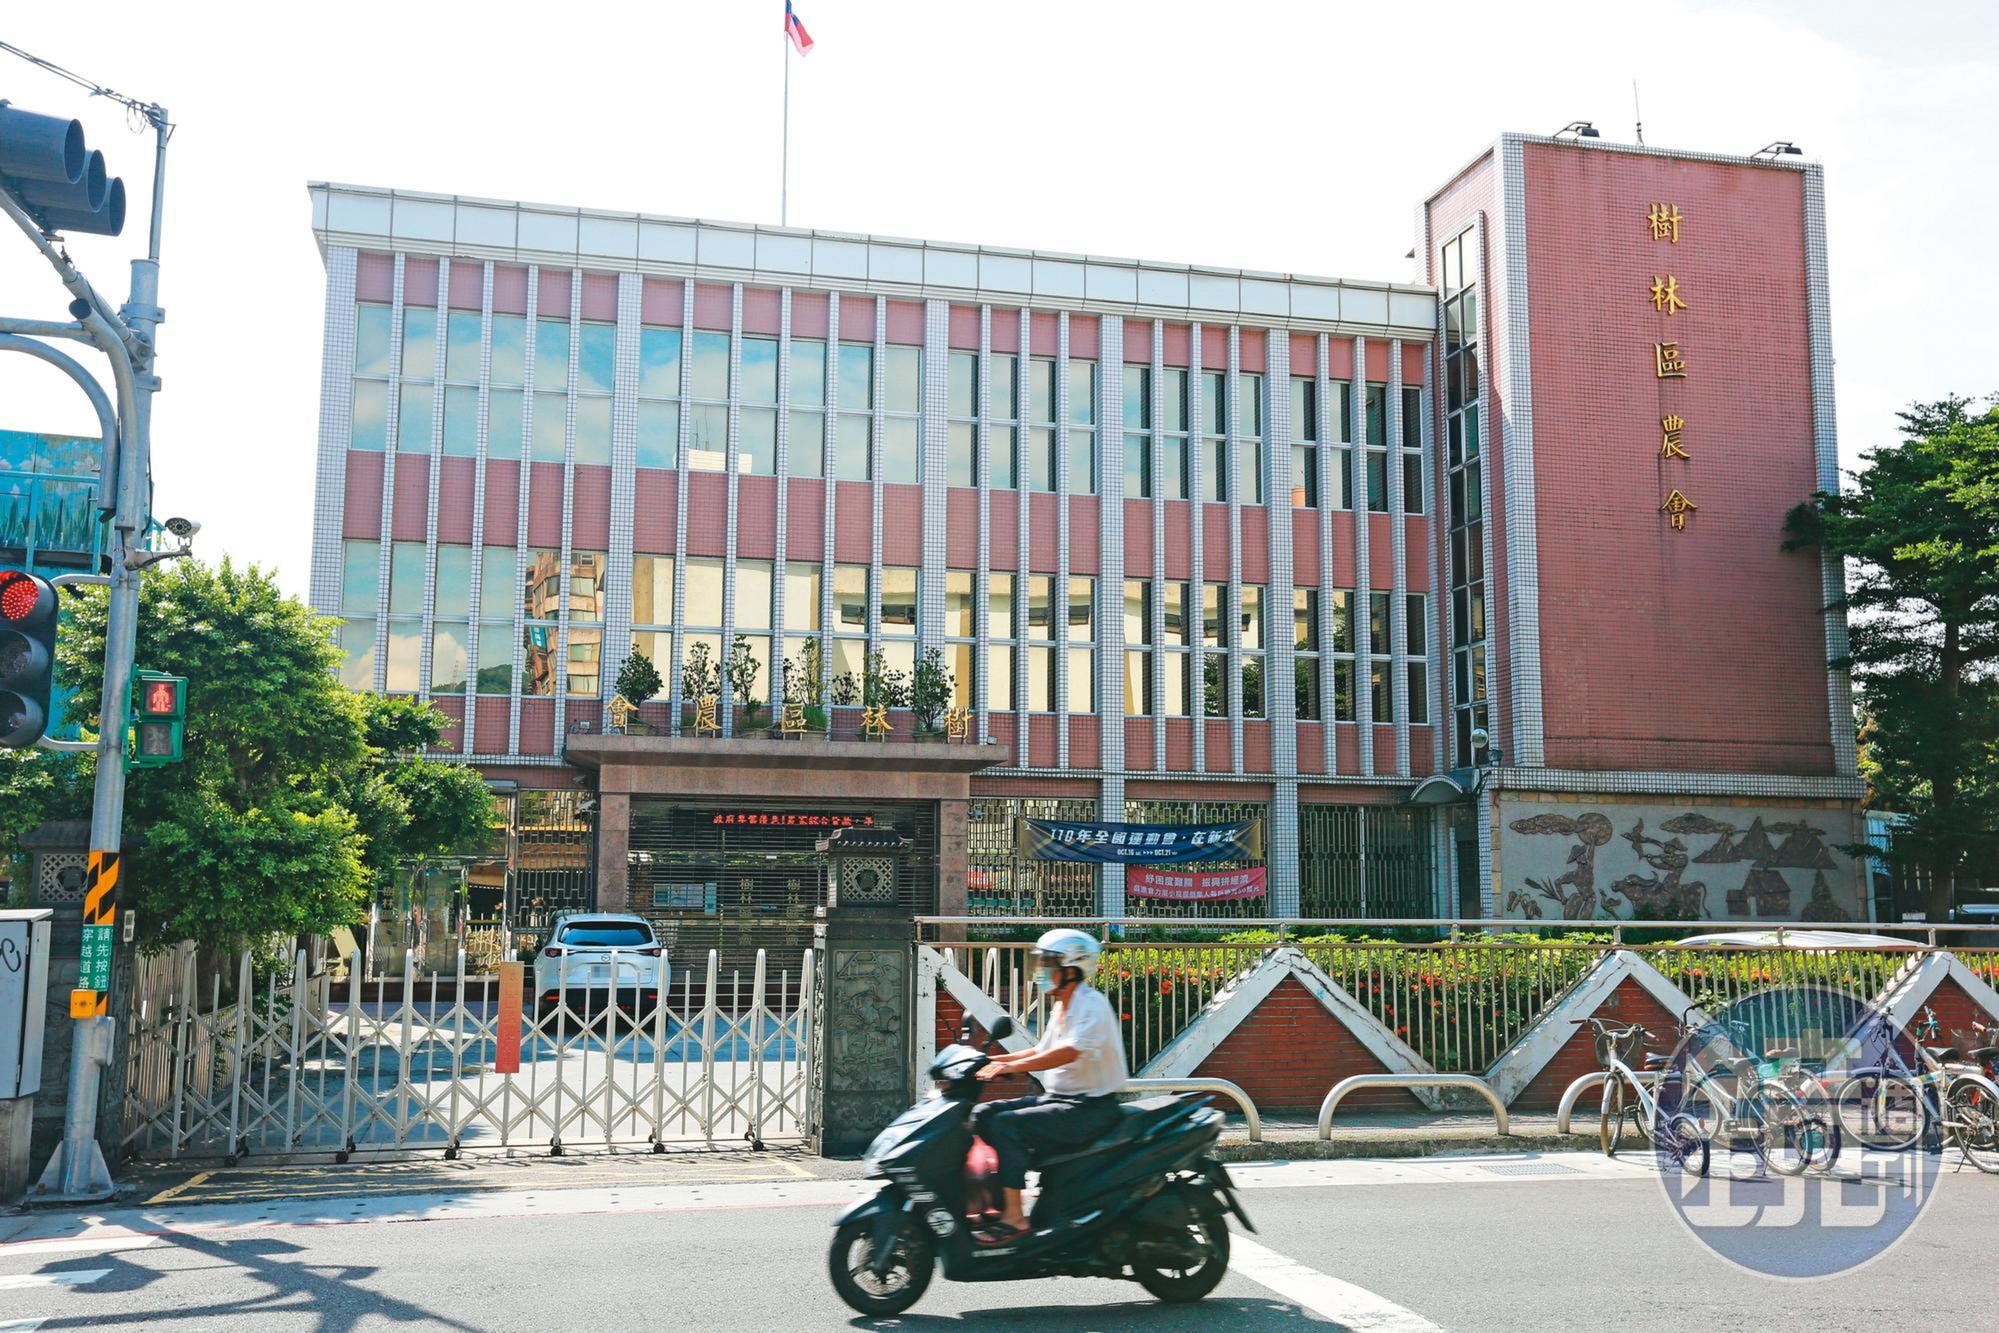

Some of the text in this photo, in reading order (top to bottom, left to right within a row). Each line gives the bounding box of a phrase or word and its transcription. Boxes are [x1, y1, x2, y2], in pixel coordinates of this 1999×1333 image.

[1647, 201, 1698, 530] 樹林區農會
[78, 928, 94, 989] 穿越道路
[94, 927, 111, 989] 請先按鈕
